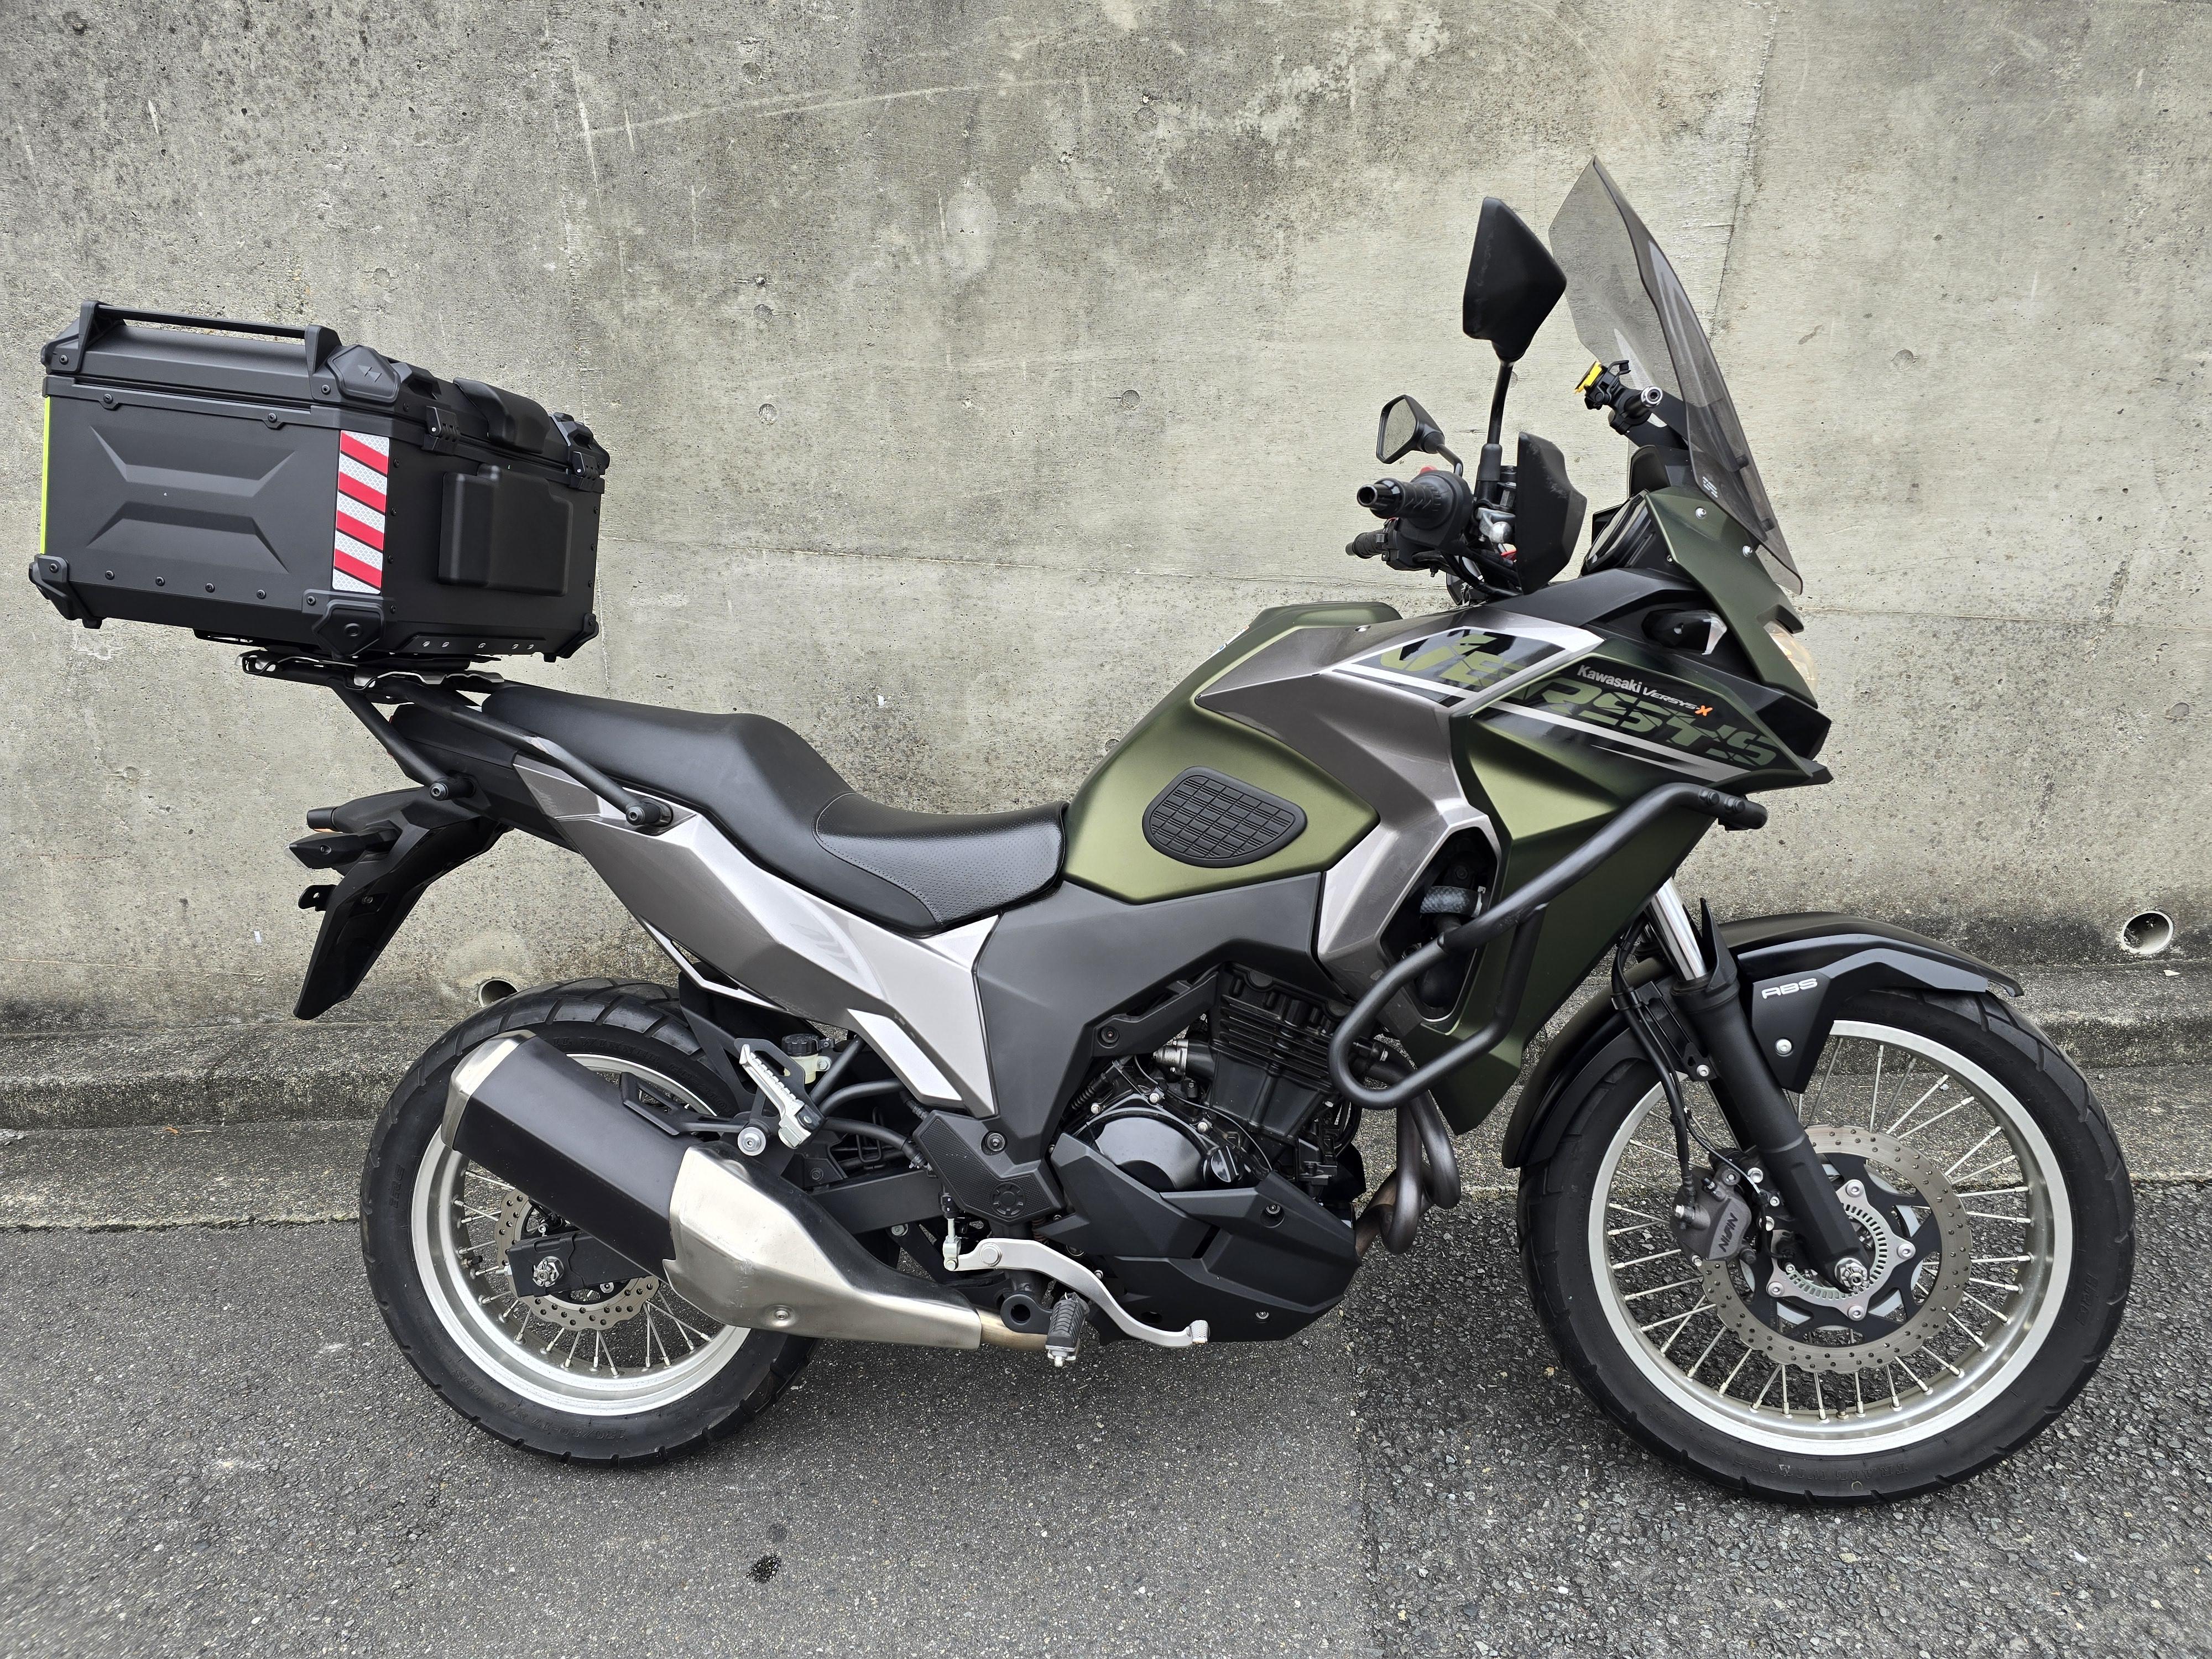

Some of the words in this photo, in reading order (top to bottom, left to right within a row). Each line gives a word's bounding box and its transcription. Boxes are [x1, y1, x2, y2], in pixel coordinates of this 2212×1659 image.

[1577, 664, 1642, 693] Kawasaki
[1643, 687, 1713, 717] VERSYS-X
[1761, 978, 1818, 999] ABS
[1837, 1462, 1910, 1481] TRAIL
